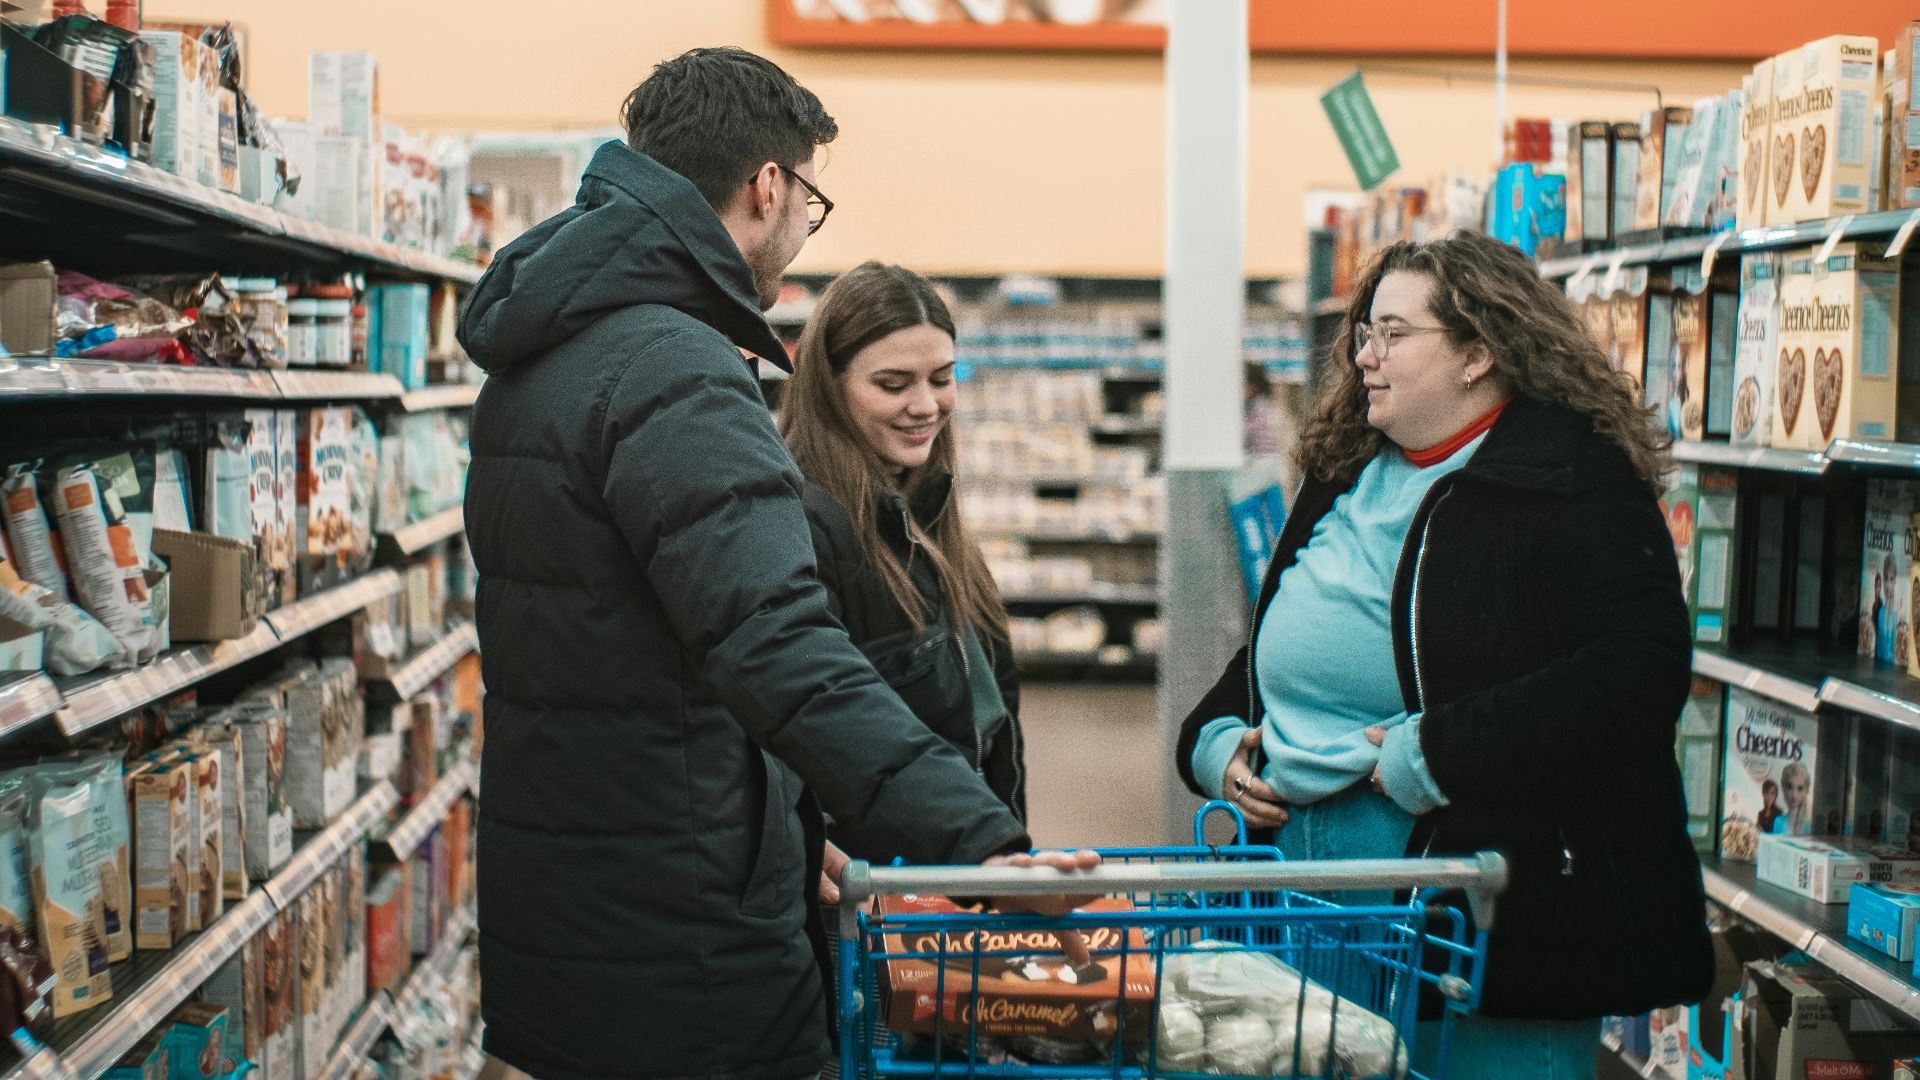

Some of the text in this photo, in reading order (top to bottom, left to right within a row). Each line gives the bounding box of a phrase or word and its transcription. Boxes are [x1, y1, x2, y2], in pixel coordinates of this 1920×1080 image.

[1840, 44, 1872, 56] Cheerios
[1802, 86, 1833, 113] Cheerios
[1812, 296, 1850, 331] Cheerios
[1866, 521, 1894, 553] Cheerios
[1736, 724, 1803, 761] Cheerios
[1869, 863, 1893, 872] FLAKES
[1869, 872, 1893, 882] CORN
[1817, 1065, 1838, 1076] Malt
